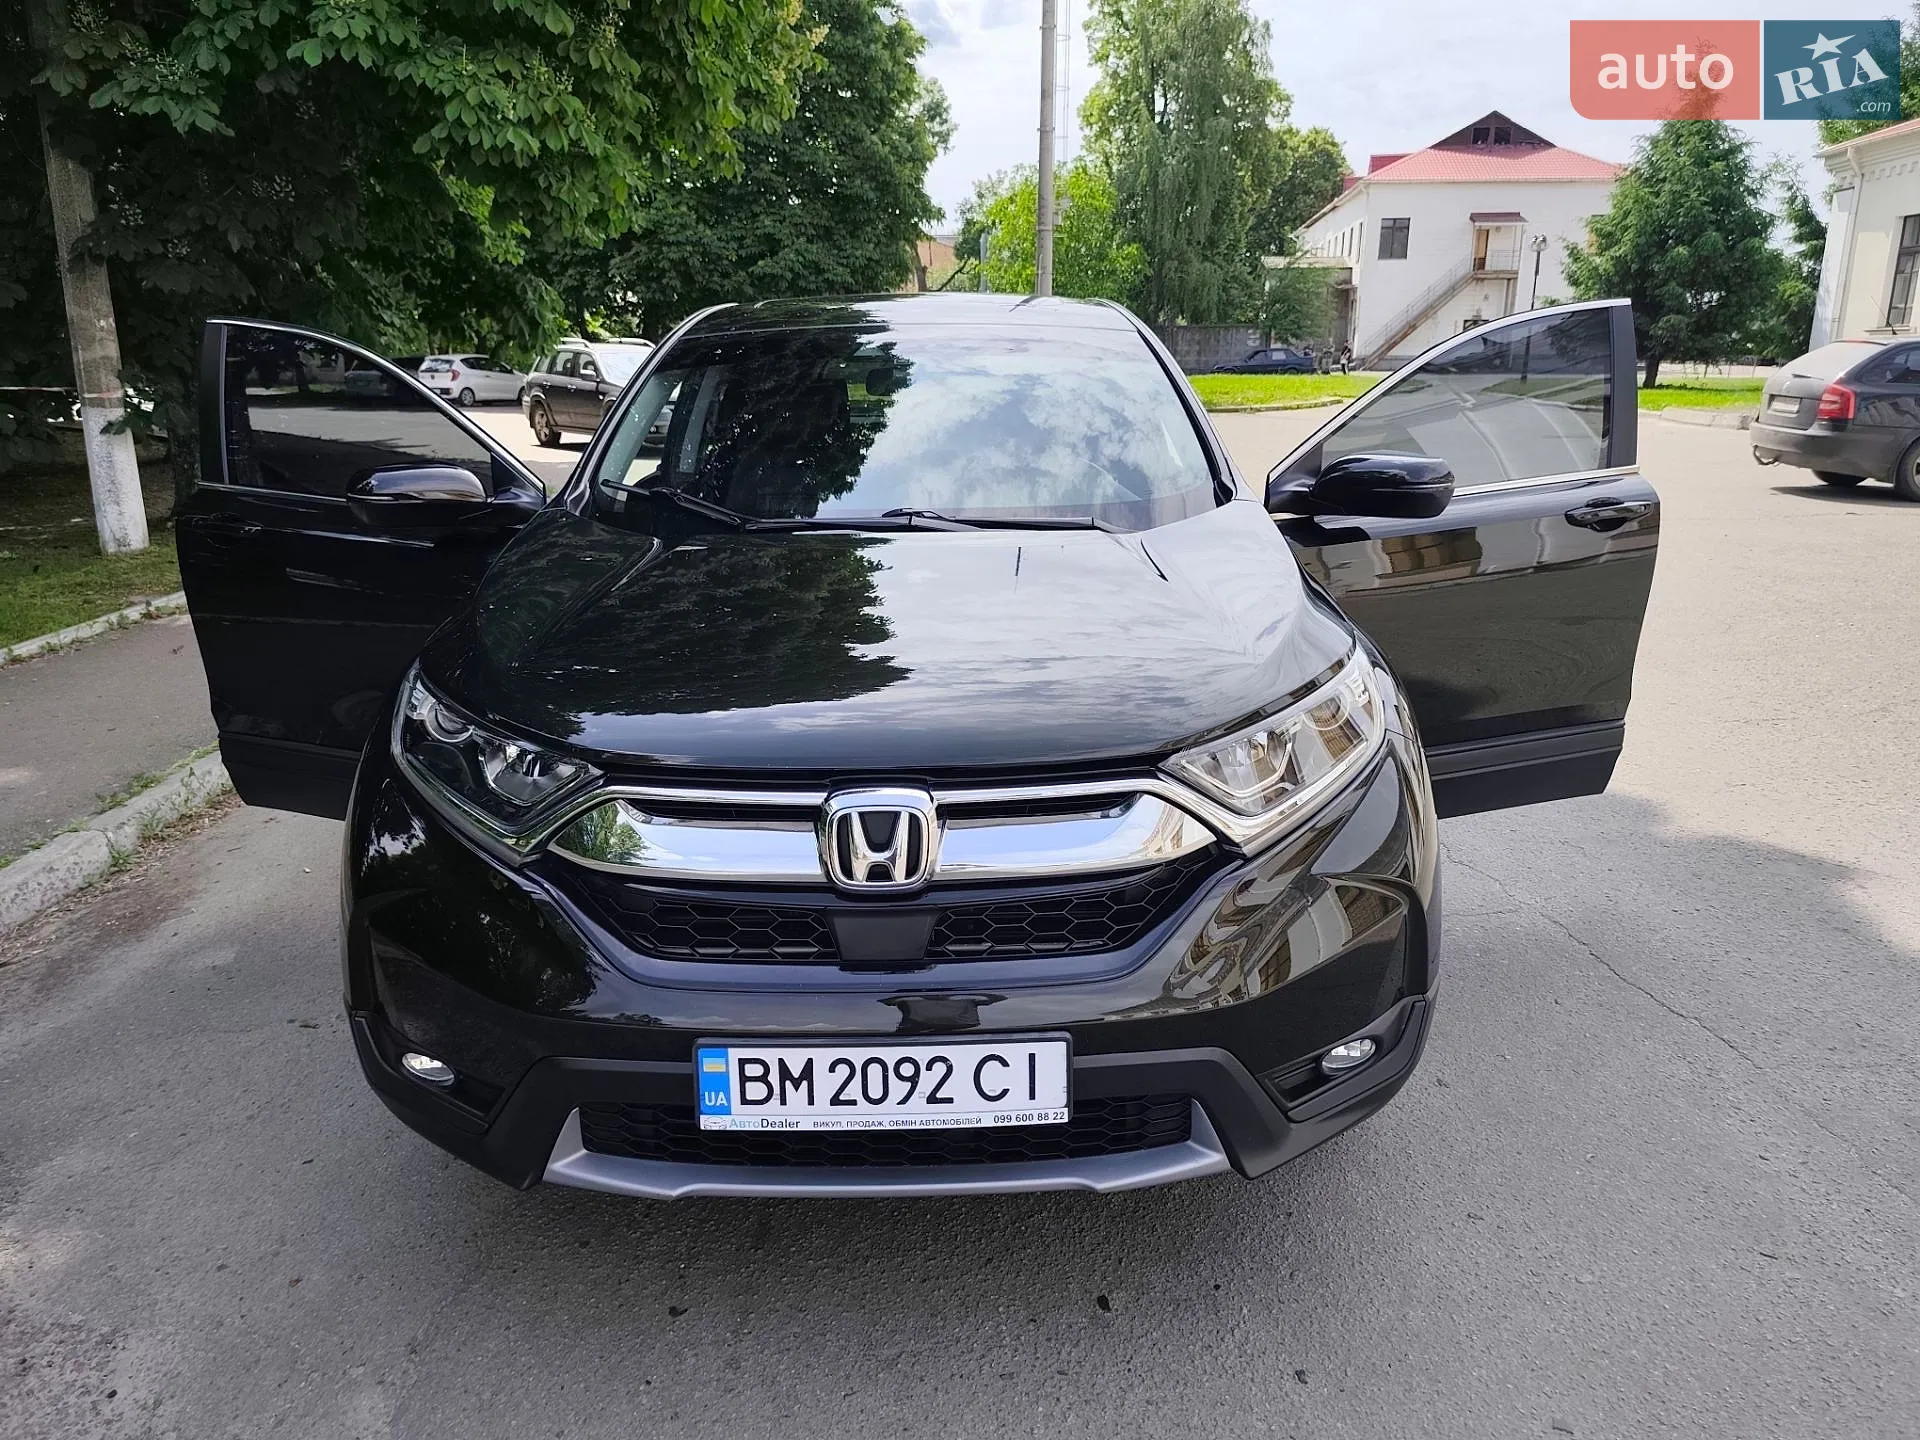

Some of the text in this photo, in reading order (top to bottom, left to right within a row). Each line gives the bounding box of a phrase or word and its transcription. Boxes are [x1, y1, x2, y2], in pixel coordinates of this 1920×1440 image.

[737, 1057, 815, 1106] BM
[828, 1055, 955, 1106] 2092
[704, 1091, 728, 1107] UA
[919, 1117, 982, 1127] АВТОМОБІЛЕЙ
[993, 1111, 1065, 1124] 099 600 88 22
